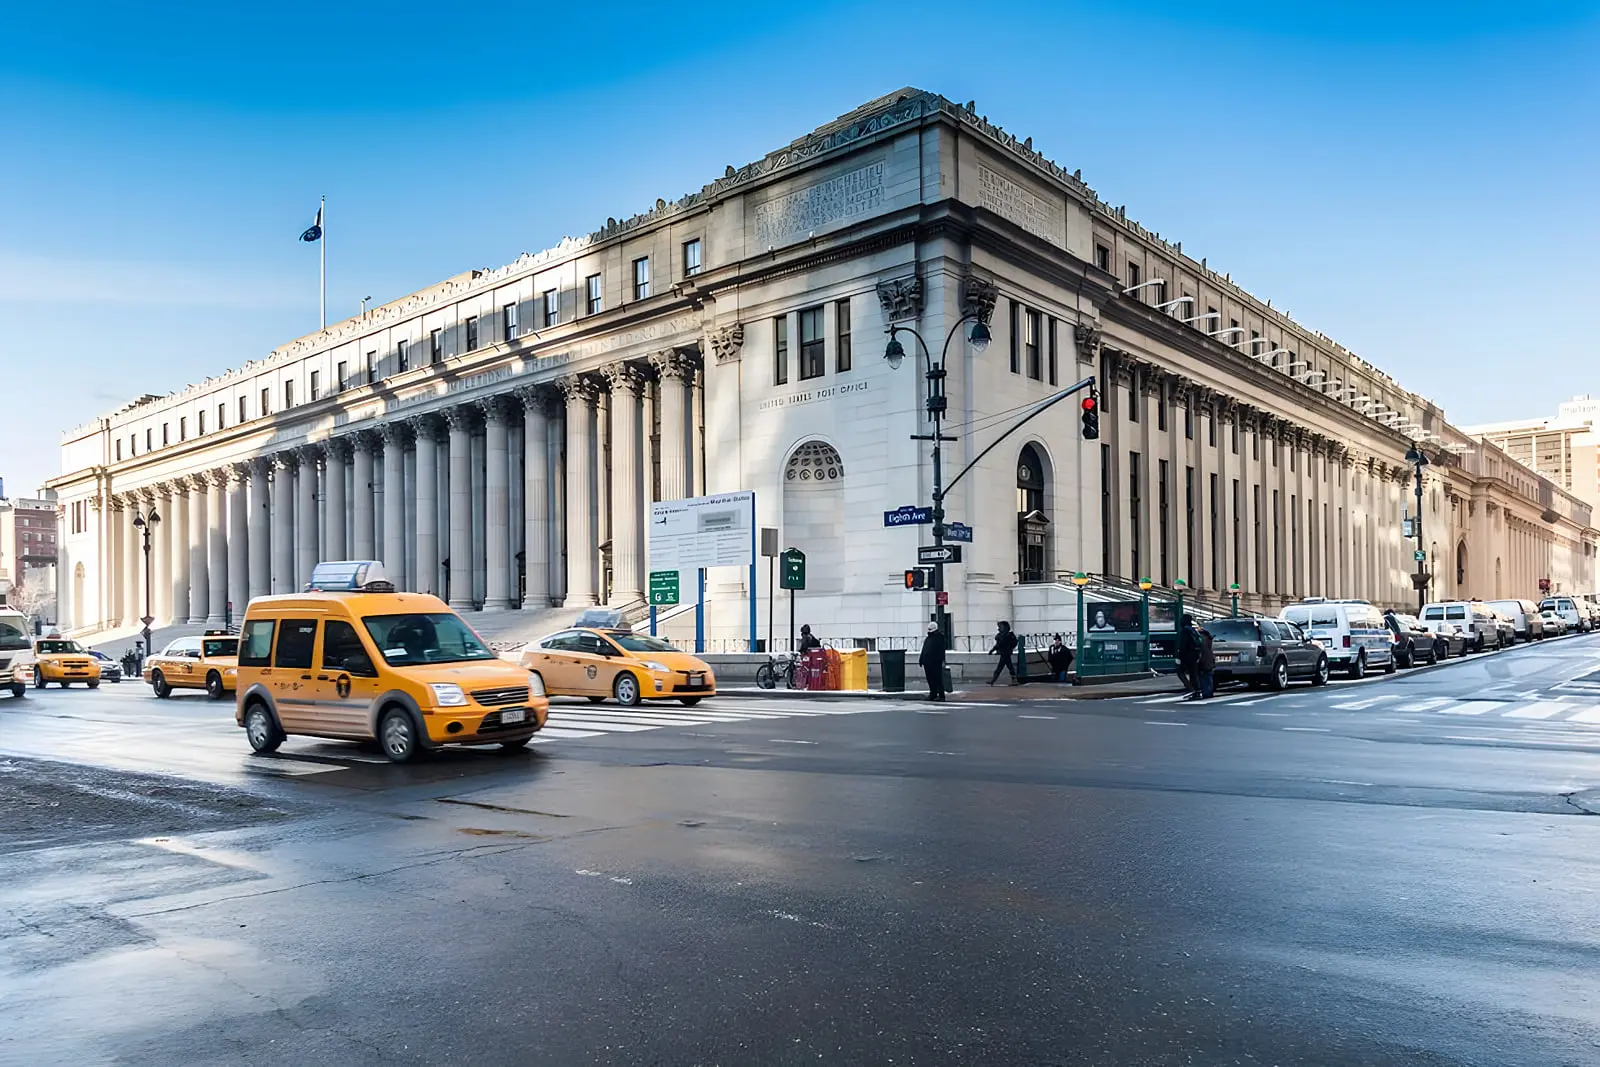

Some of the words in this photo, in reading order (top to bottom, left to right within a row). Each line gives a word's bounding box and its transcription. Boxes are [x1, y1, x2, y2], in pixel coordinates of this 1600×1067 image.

[840, 381, 868, 394] OFFICE
[889, 513, 910, 523] Eighth
[912, 512, 926, 520] Ave
